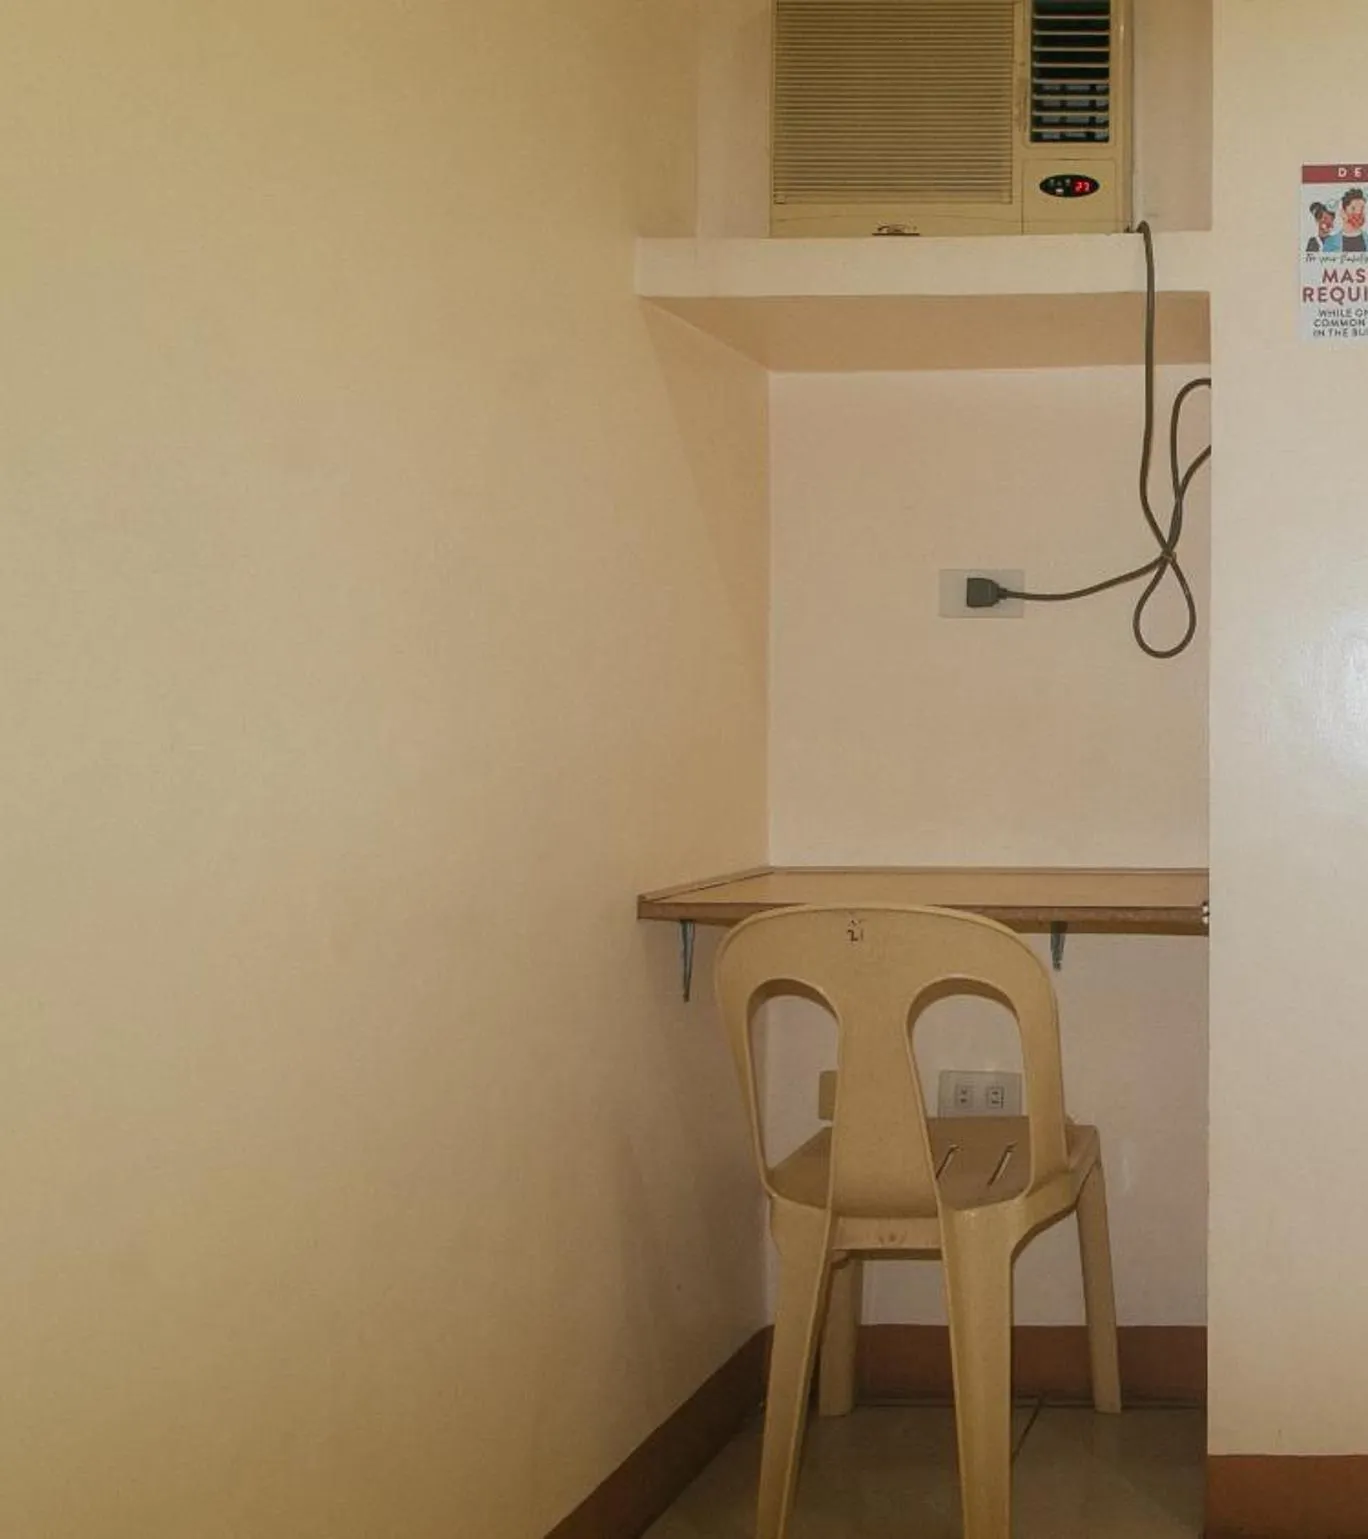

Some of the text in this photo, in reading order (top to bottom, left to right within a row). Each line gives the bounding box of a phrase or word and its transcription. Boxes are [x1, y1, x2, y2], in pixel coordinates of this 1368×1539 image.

[1318, 308, 1353, 318] WHILE
[1312, 318, 1366, 328] COMMON
[1312, 328, 1325, 337] IN
[1328, 328, 1349, 338] THE
